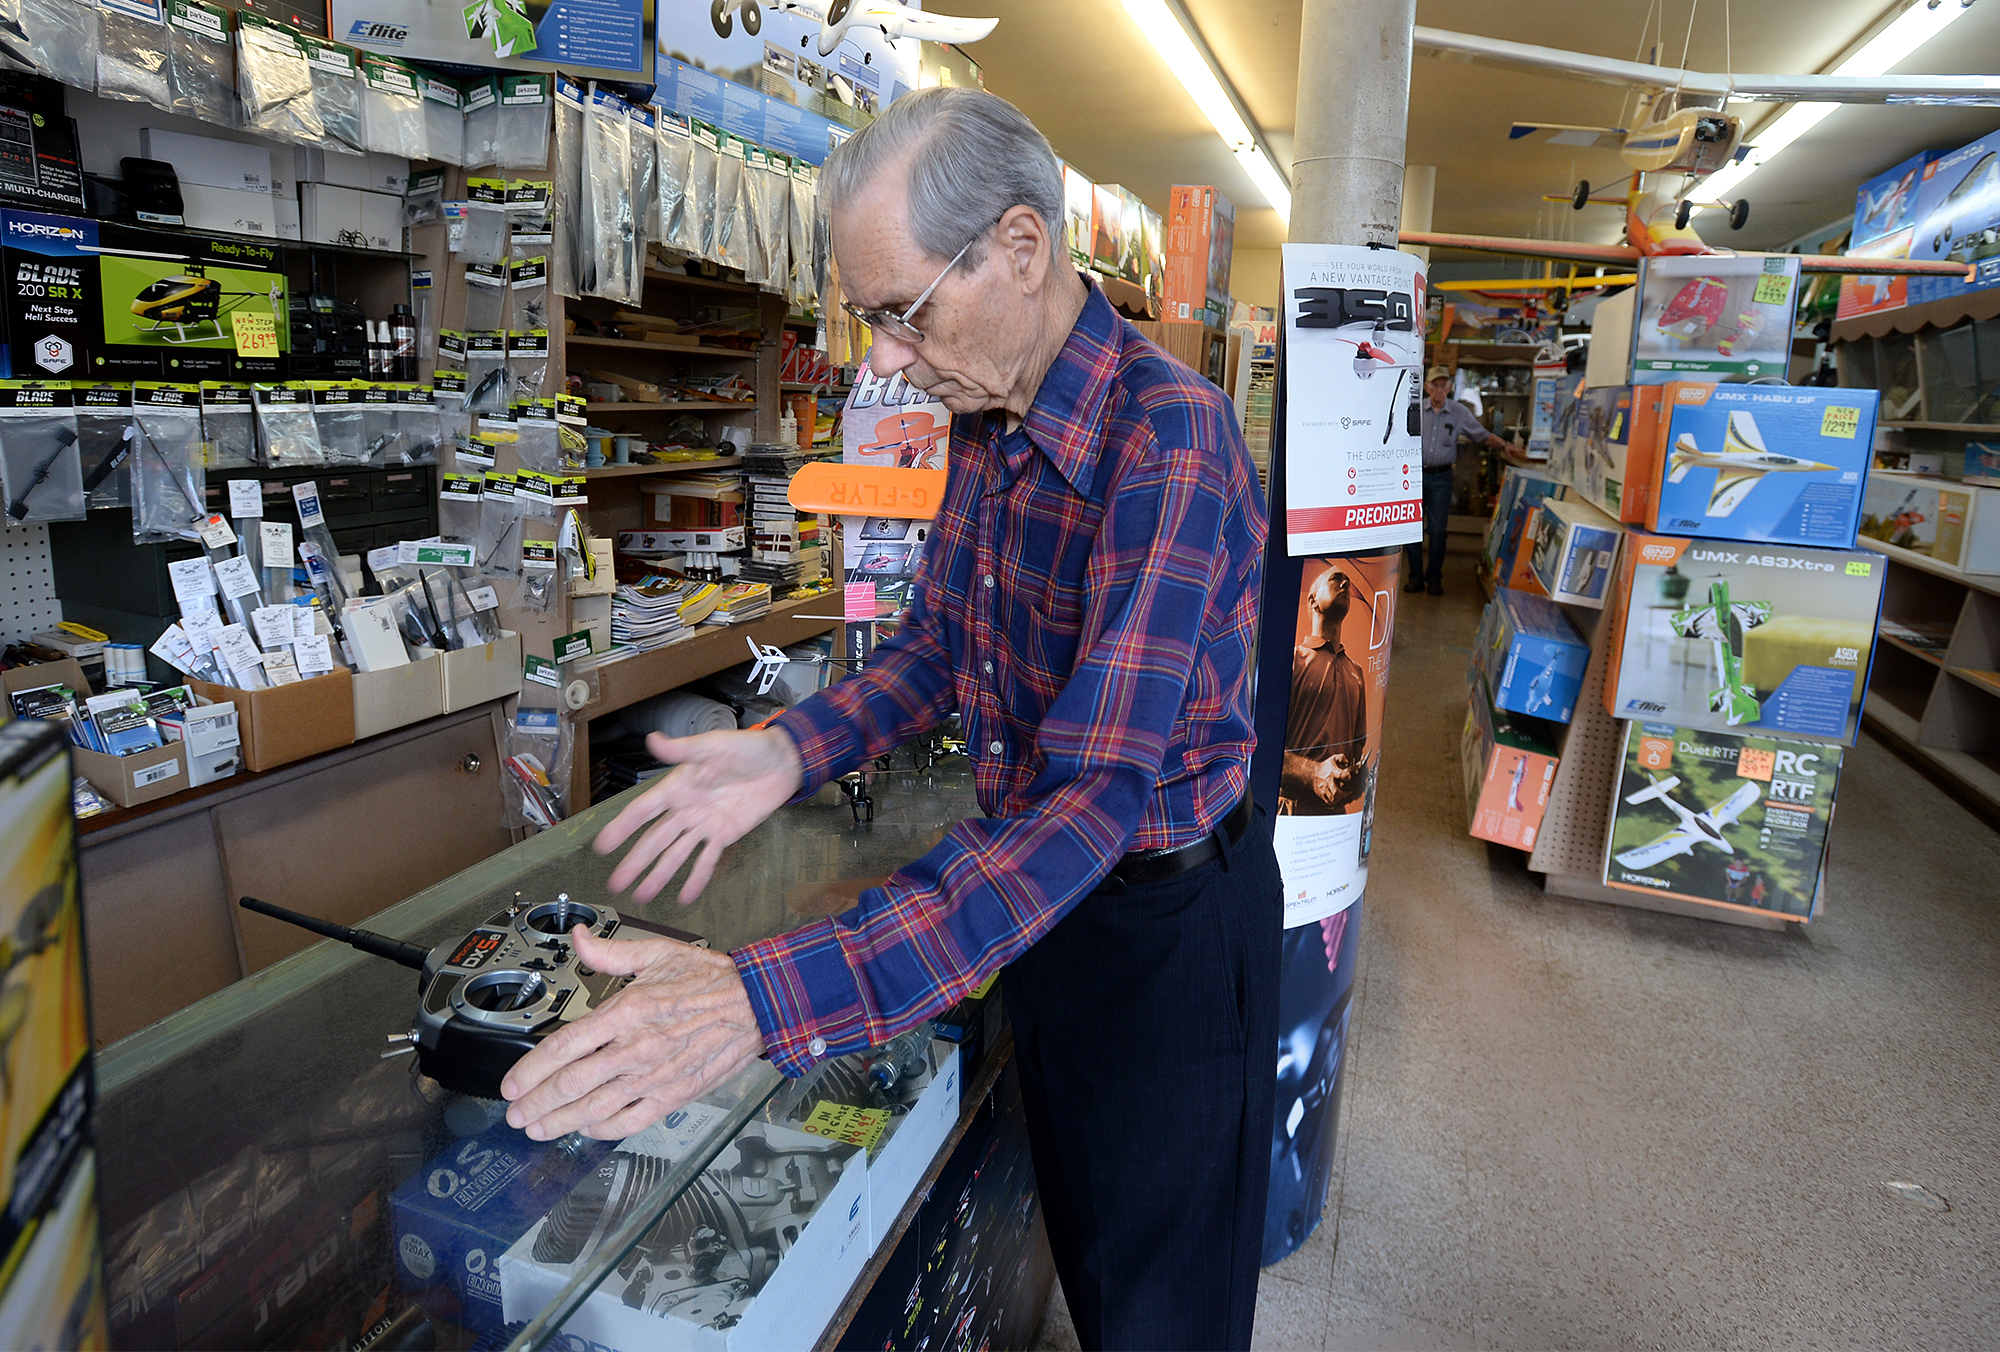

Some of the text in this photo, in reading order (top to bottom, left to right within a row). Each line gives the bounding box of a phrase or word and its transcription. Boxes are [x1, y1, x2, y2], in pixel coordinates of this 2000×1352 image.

[189, 11, 218, 25] parkzone
[350, 20, 409, 41] E-flite
[321, 51, 348, 64] parkzone
[385, 71, 410, 84] parkzone
[5, 182, 82, 204] MULTI-CHARGER
[211, 241, 275, 261] Ready-To-Fly
[17, 262, 83, 286] BLADE
[1330, 261, 1343, 269] SEE
[1347, 262, 1365, 270] YOUR
[1367, 264, 1388, 272] WORLD
[1310, 272, 1318, 282] A
[1322, 272, 1346, 283] NEW
[1349, 273, 1391, 286] VANTAGE
[18, 284, 83, 300] 200 SR X
[31, 304, 74, 317] Next Step
[1294, 287, 1413, 332] 350
[25, 312, 78, 325] Heli Success
[16, 391, 55, 402] BLADE
[86, 391, 120, 402] BLADE
[151, 391, 186, 404] BLADE
[1715, 391, 1750, 402] UMX
[1753, 393, 1793, 404] HABU
[1346, 451, 1363, 461] THE
[1345, 503, 1416, 527] PREORDER
[1692, 550, 1741, 565] UMX
[1745, 556, 1835, 573] AS3Xtra
[1679, 741, 1820, 777] Duet RTF RC
[1769, 779, 1816, 800] RTF
[1285, 896, 1318, 909] SPEKTRUM
[452, 935, 481, 964] SPEKTRUM
[461, 933, 502, 969] DX5e
[687, 1114, 709, 1137] SMALL
[453, 1152, 517, 1207] ENGINE
[410, 1235, 424, 1246] MAX
[404, 1242, 431, 1260] 120AX
